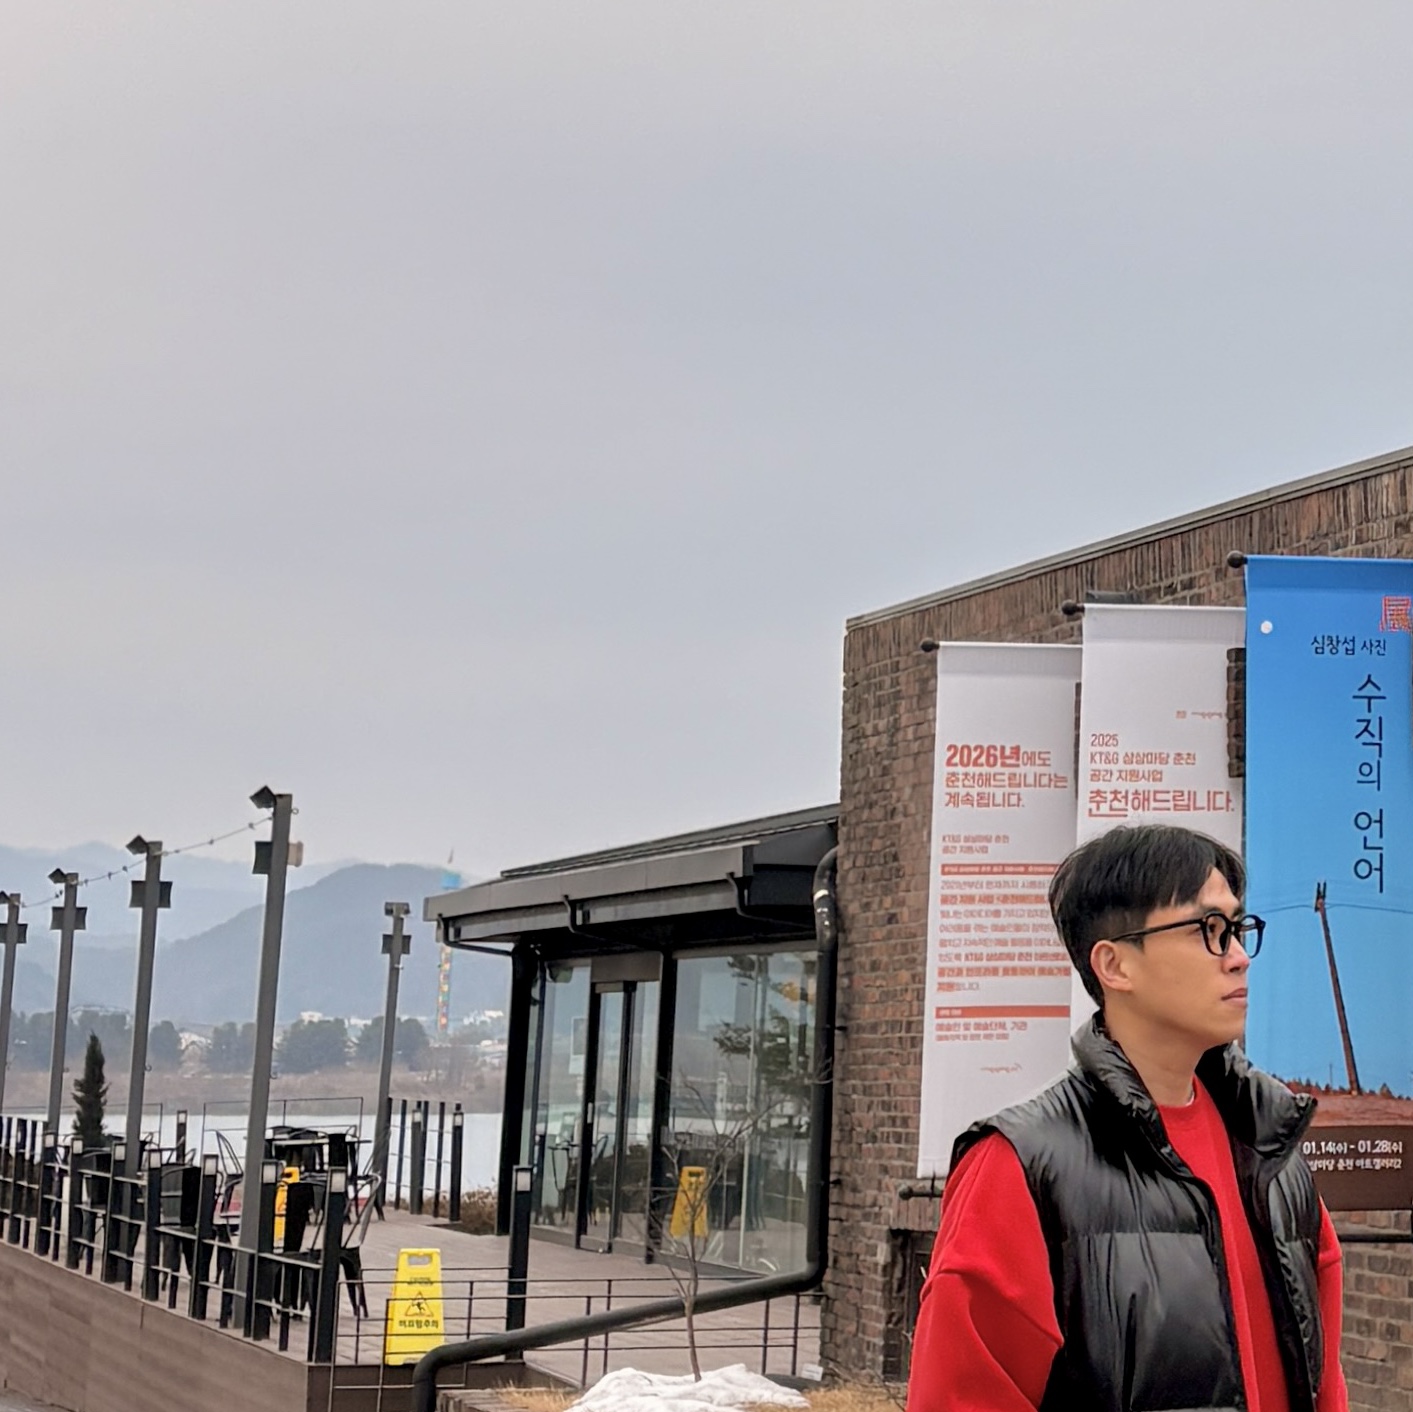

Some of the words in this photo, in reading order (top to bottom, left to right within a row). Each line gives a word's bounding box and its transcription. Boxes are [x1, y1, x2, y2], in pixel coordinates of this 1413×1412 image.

[1361, 638, 1386, 656] 사진
[1091, 733, 1119, 747] 2025
[1352, 674, 1387, 791] 수직의
[945, 744, 1051, 768] 2026년에도
[1090, 752, 1119, 765] KT&G
[1123, 752, 1170, 765] 상상마당
[1090, 769, 1113, 782] 공간
[1116, 769, 1163, 782] 지원사업
[945, 792, 1025, 808] 계속됩니다.
[1353, 808, 1384, 894] 언어
[1302, 1141, 1347, 1155] 01.14(수)
[1307, 1159, 1335, 1171] 상마당
